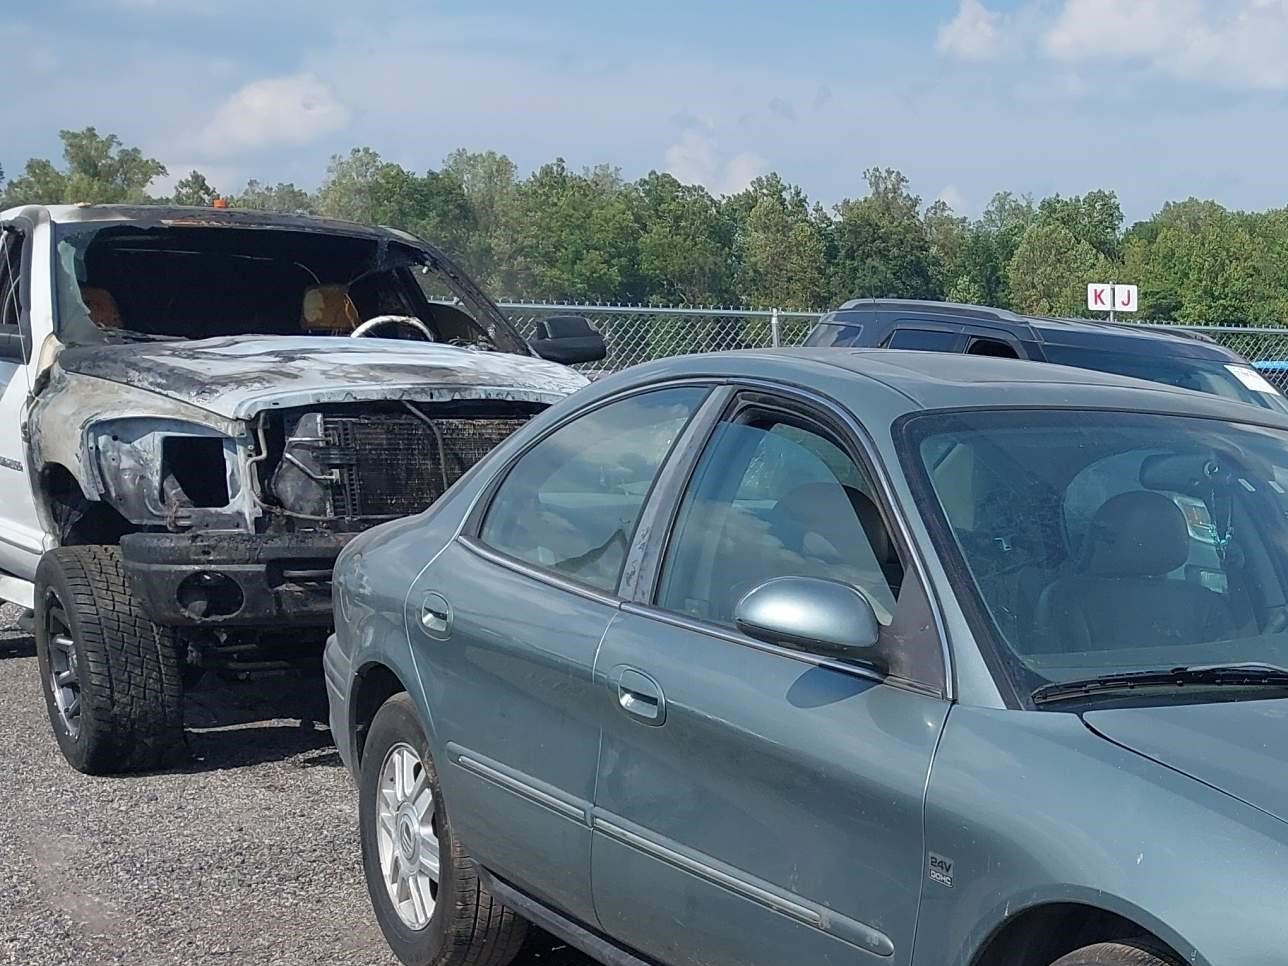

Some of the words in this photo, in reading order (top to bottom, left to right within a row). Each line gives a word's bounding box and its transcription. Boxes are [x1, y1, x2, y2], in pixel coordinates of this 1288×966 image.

[1093, 288, 1106, 306] K
[1121, 289, 1131, 307] J
[930, 856, 952, 873] 24V
[930, 869, 952, 885] DOHC
